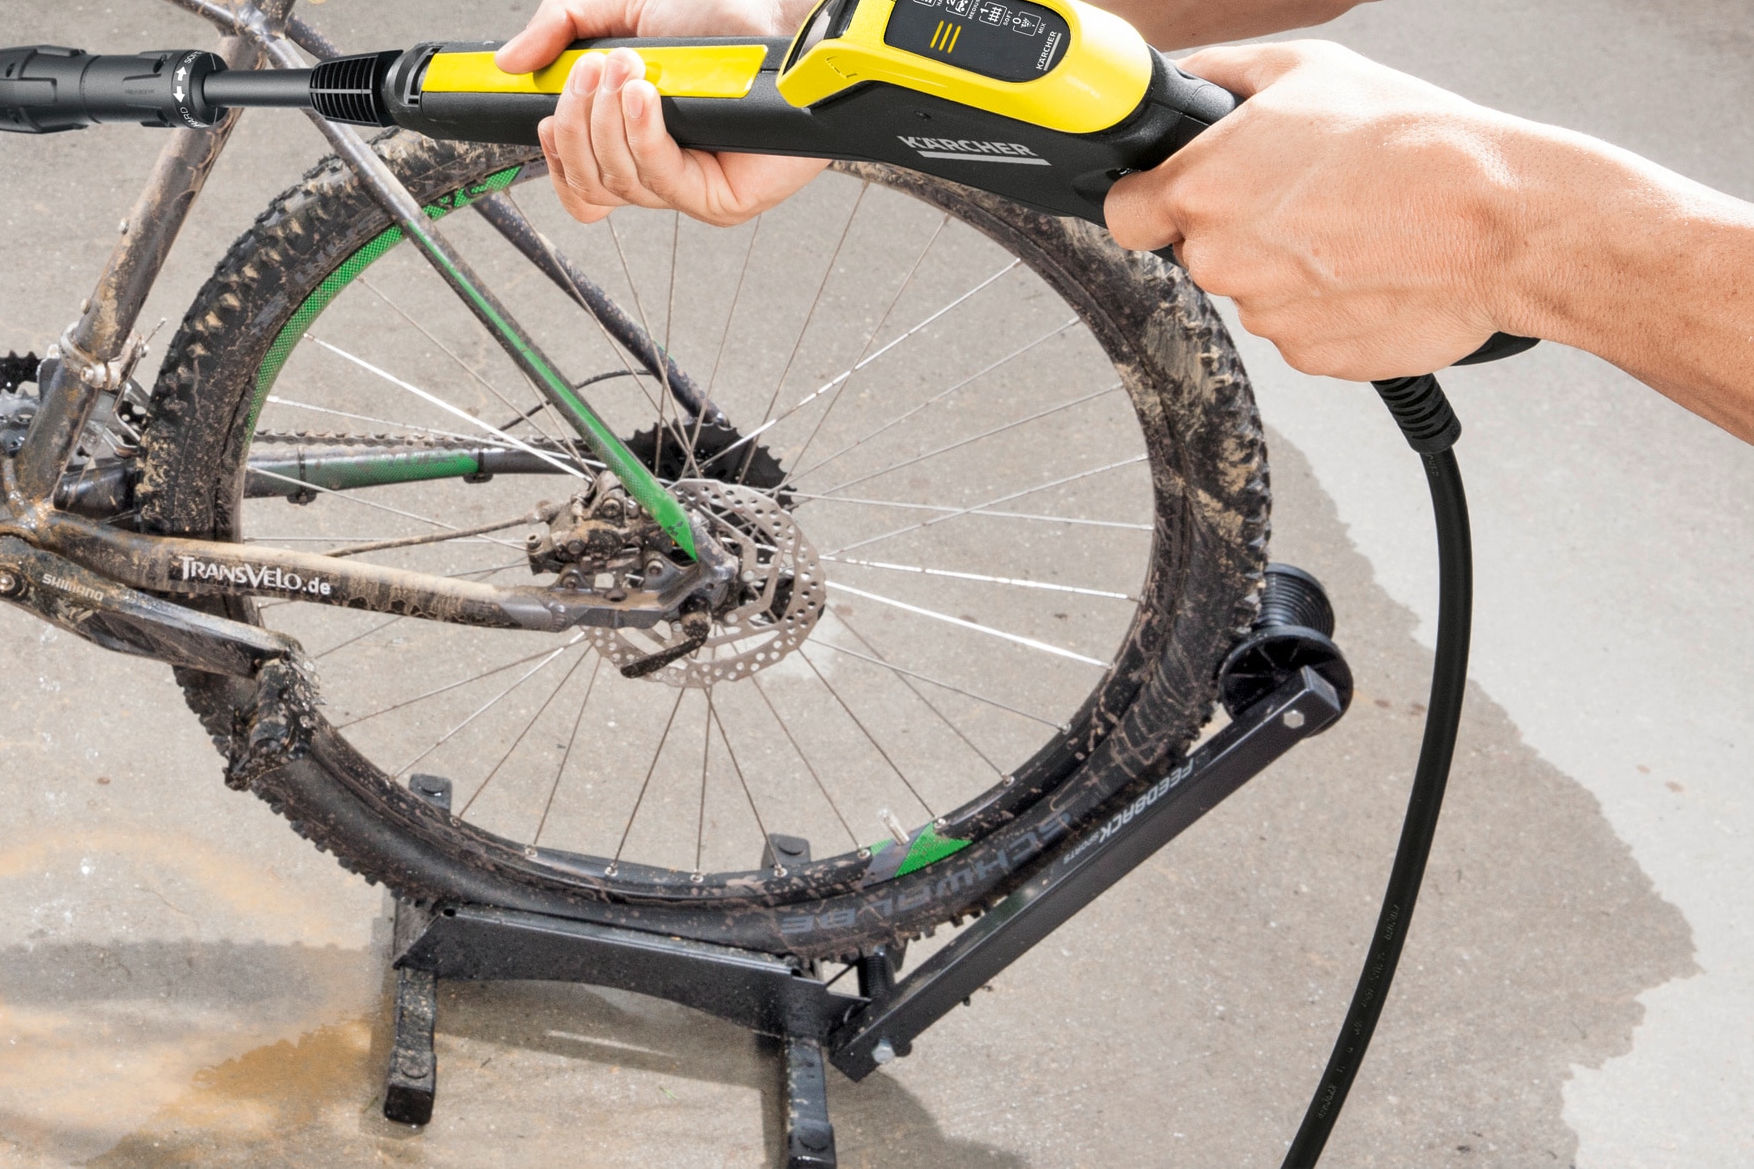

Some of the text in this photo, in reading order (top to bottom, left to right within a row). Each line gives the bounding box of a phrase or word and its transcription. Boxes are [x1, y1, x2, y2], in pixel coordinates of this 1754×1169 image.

[1003, 10, 1014, 26] SOFT
[1012, 17, 1022, 25] 0
[1037, 23, 1048, 35] MIX
[1035, 31, 1058, 70] KÄRCHER
[896, 135, 1039, 157] KÄRCHER
[41, 573, 105, 601] SHIMANO
[1099, 758, 1195, 843] FEEDBACK
[779, 811, 1073, 934] SCHWALBE
